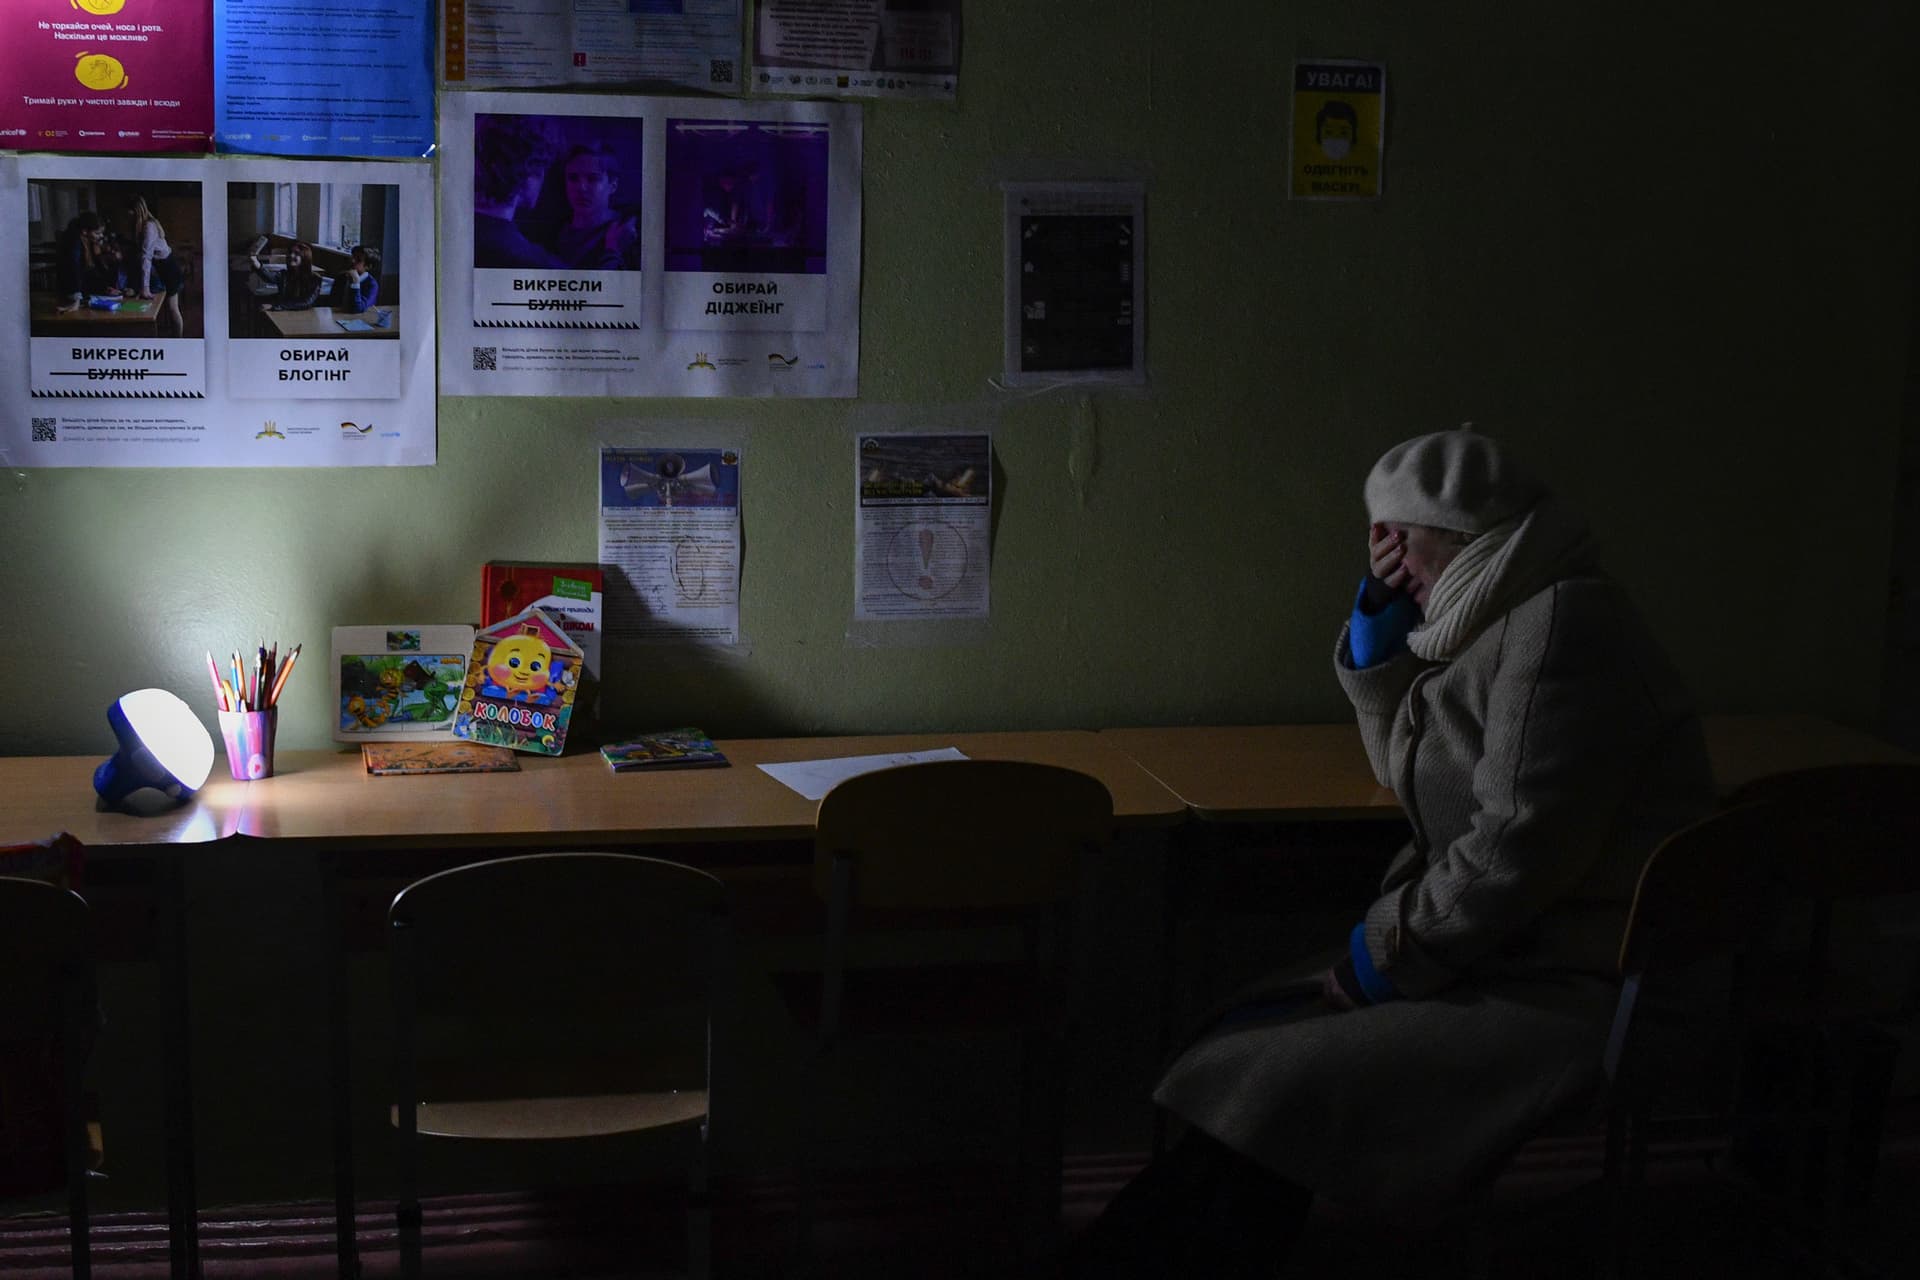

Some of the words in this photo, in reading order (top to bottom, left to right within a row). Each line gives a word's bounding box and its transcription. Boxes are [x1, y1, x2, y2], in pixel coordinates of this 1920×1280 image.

[38, 21, 50, 29] Не
[52, 22, 89, 31] торкайся
[91, 23, 114, 31] очей,
[142, 24, 163, 33] рота.
[54, 32, 95, 41] Наскільки
[97, 33, 108, 42] це
[109, 34, 148, 42] можливо
[1307, 72, 1374, 88] УВАГА!
[23, 96, 56, 105] Тримай
[57, 98, 77, 107] руки
[85, 98, 115, 106] чистоті
[117, 99, 148, 107] завжди
[154, 100, 181, 108] всюди
[513, 279, 603, 292] ВИКРЕСЛИ
[712, 281, 778, 295] ОБИРАЙ
[528, 298, 588, 311] БУЛІНГ
[705, 301, 784, 315] ДІДЖЕЇНГ
[71, 348, 165, 361] ВИКРЕСЛИ
[279, 348, 350, 362] ОБИРАЙ
[87, 368, 150, 381] БУЛІНГ
[278, 368, 352, 381] БЛОГІНГ
[473, 702, 556, 731] КОЛОБОК
